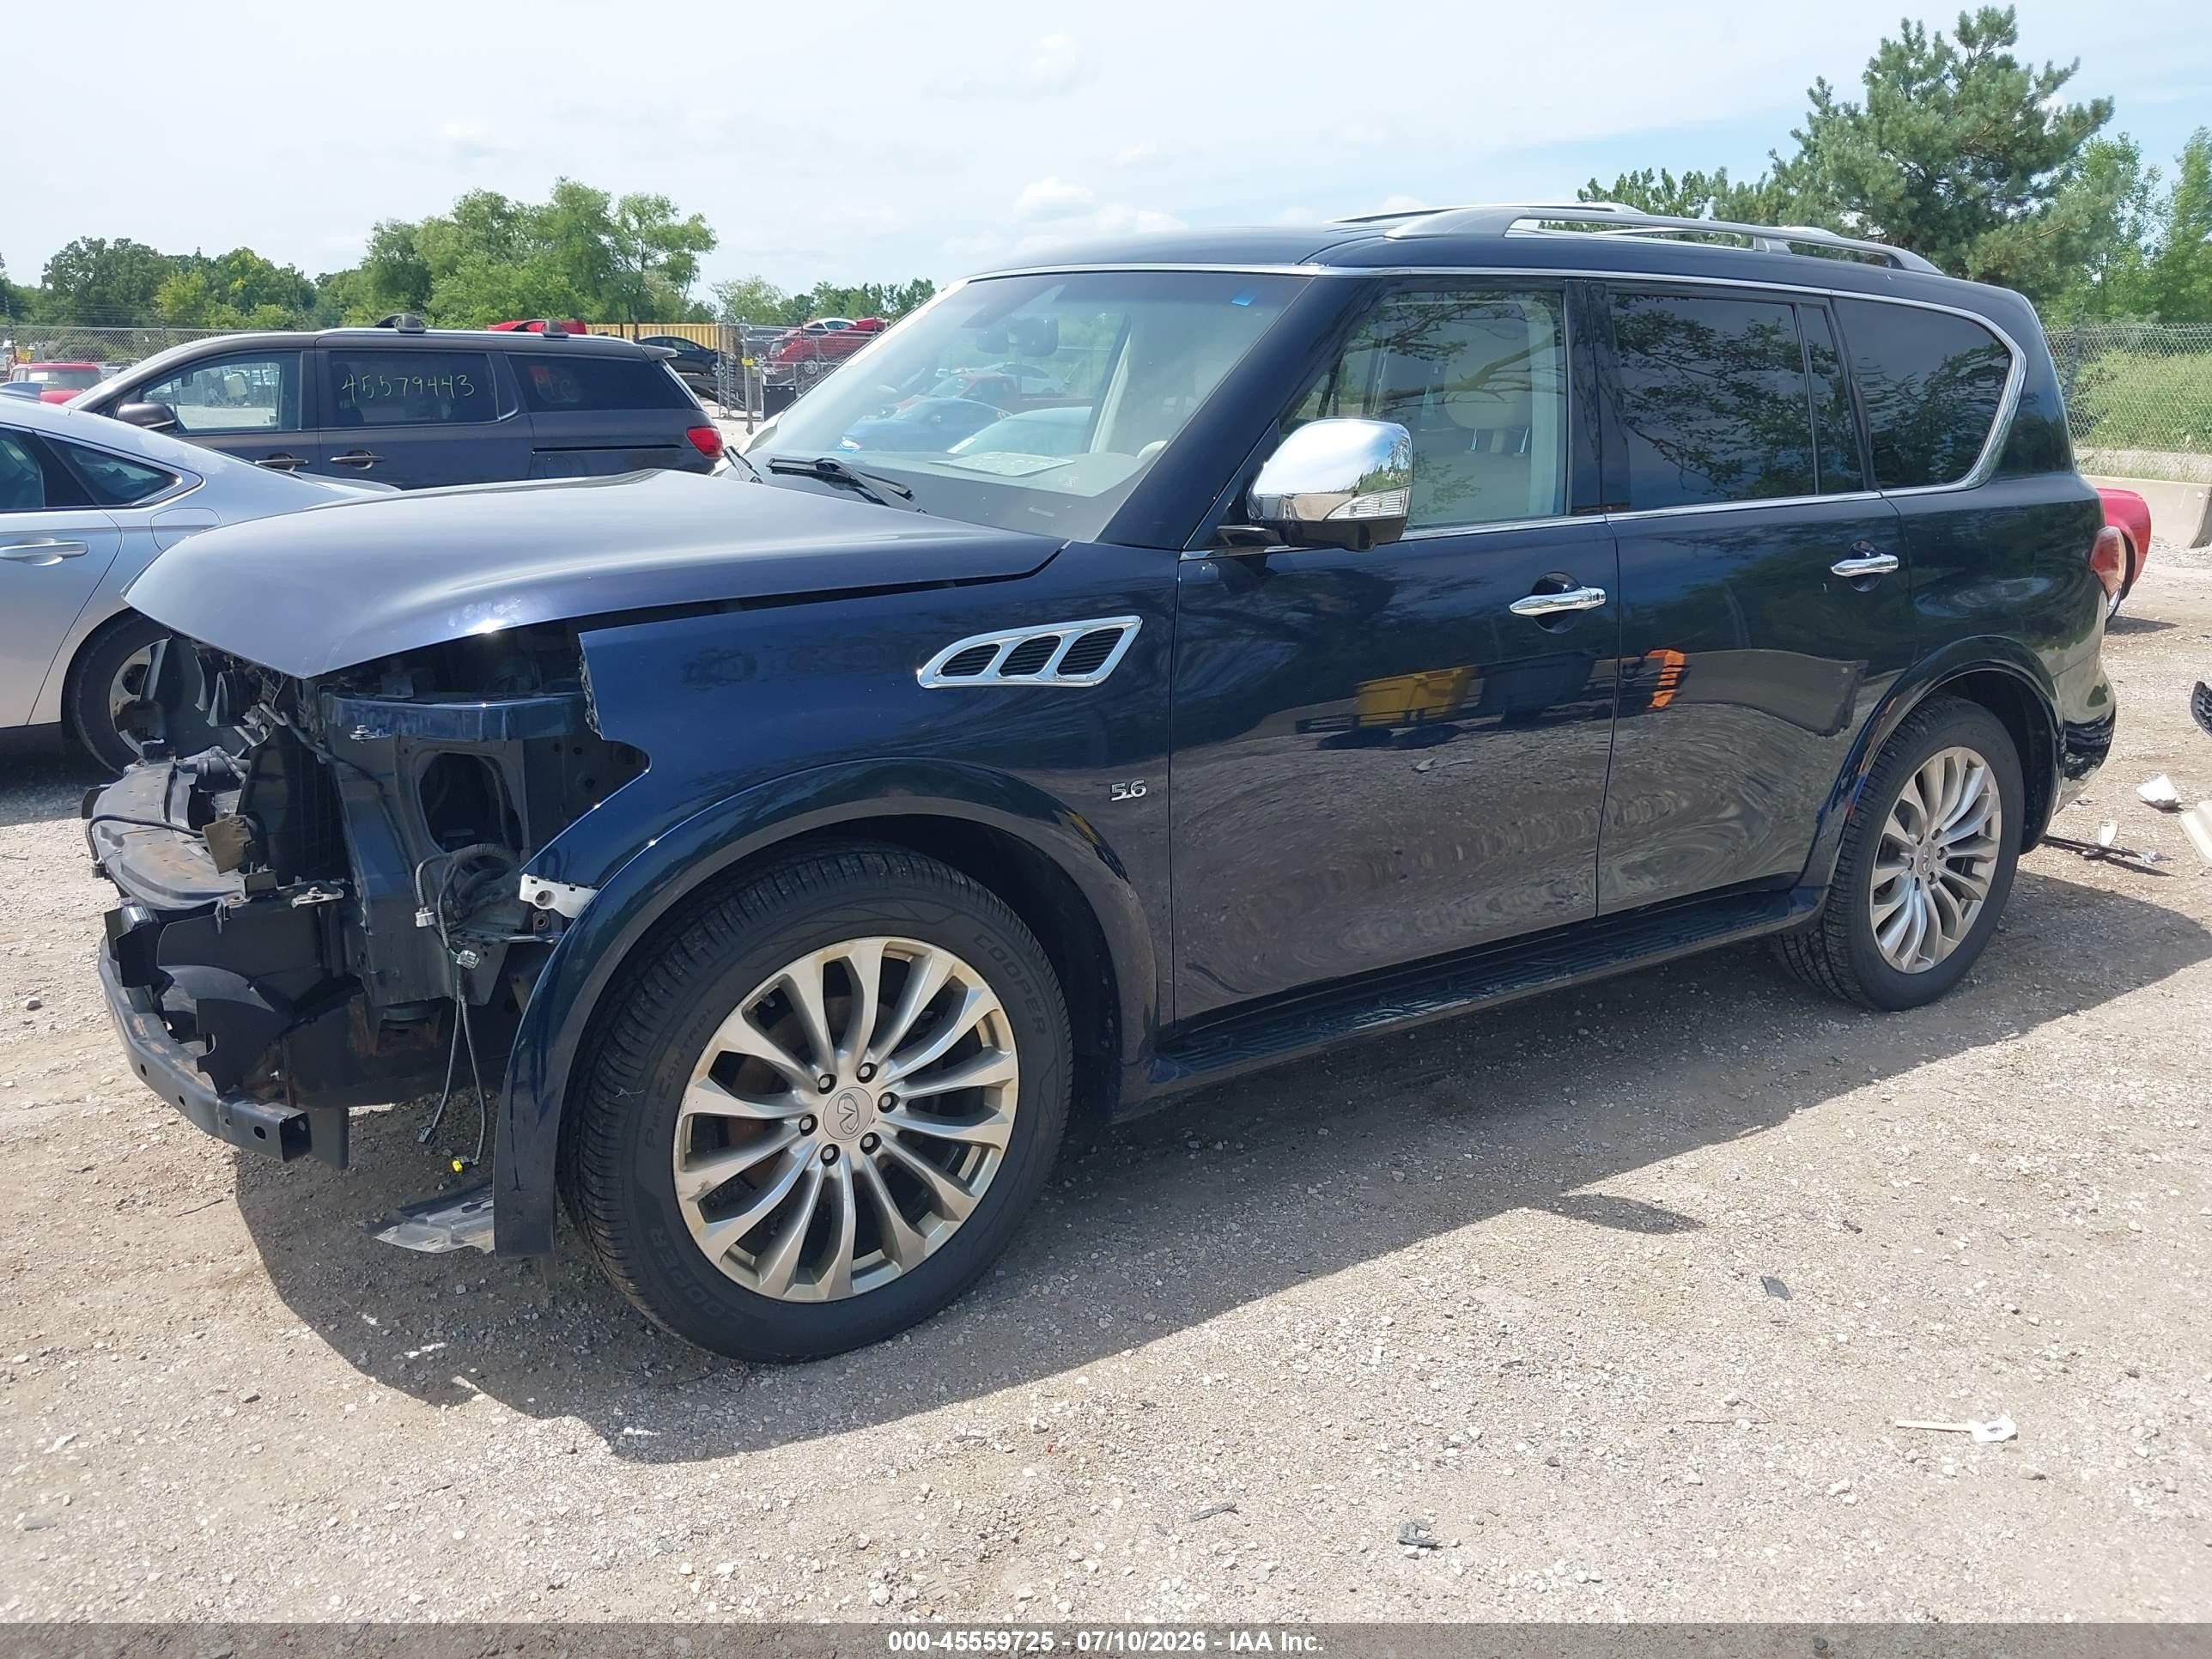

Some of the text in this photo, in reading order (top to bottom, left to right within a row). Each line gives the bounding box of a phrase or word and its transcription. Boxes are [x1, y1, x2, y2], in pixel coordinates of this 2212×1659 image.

[341, 374, 475, 404] 45579443
[973, 933, 1047, 1035] COOPER
[649, 1226, 743, 1324] COOPER
